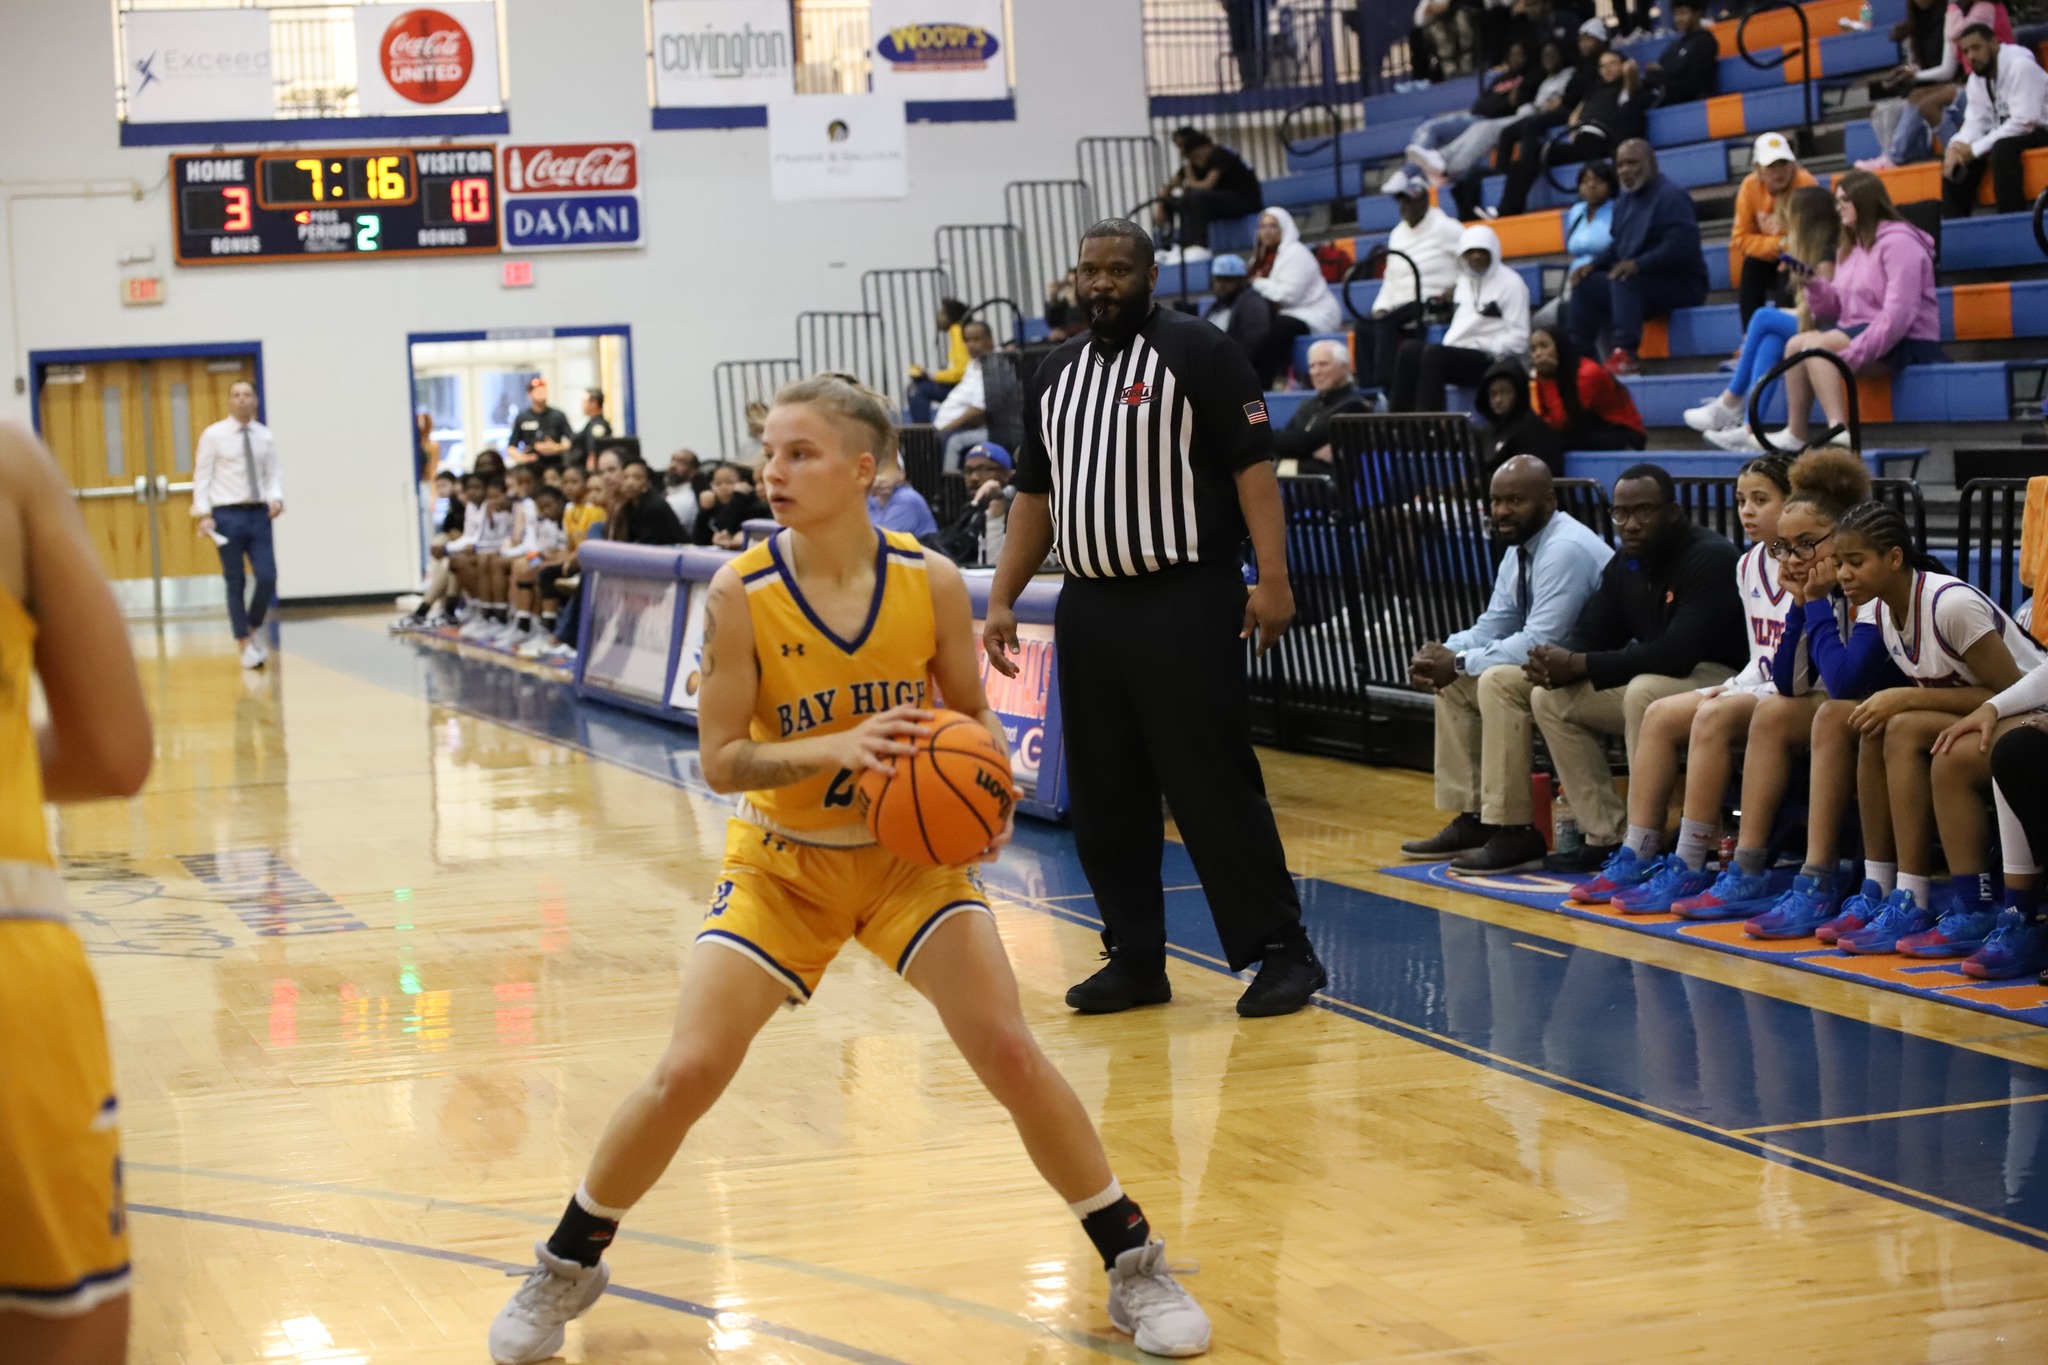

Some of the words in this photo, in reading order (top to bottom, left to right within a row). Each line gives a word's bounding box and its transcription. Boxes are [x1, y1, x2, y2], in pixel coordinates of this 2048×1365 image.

[164, 49, 270, 72] Exceed
[661, 22, 786, 79] covington
[390, 63, 463, 83] UNITED
[186, 159, 244, 182] HOME
[416, 150, 493, 175] VISITOR
[295, 155, 405, 201] 7:16
[221, 187, 251, 231] 3
[450, 178, 490, 222] 10
[298, 222, 351, 241] PERIOD
[356, 215, 380, 251] 2
[513, 201, 630, 241] DASANI
[211, 235, 261, 254] BONUS
[417, 228, 467, 246] BONUS
[130, 280, 157, 299] EXIT
[777, 688, 836, 738] BAY
